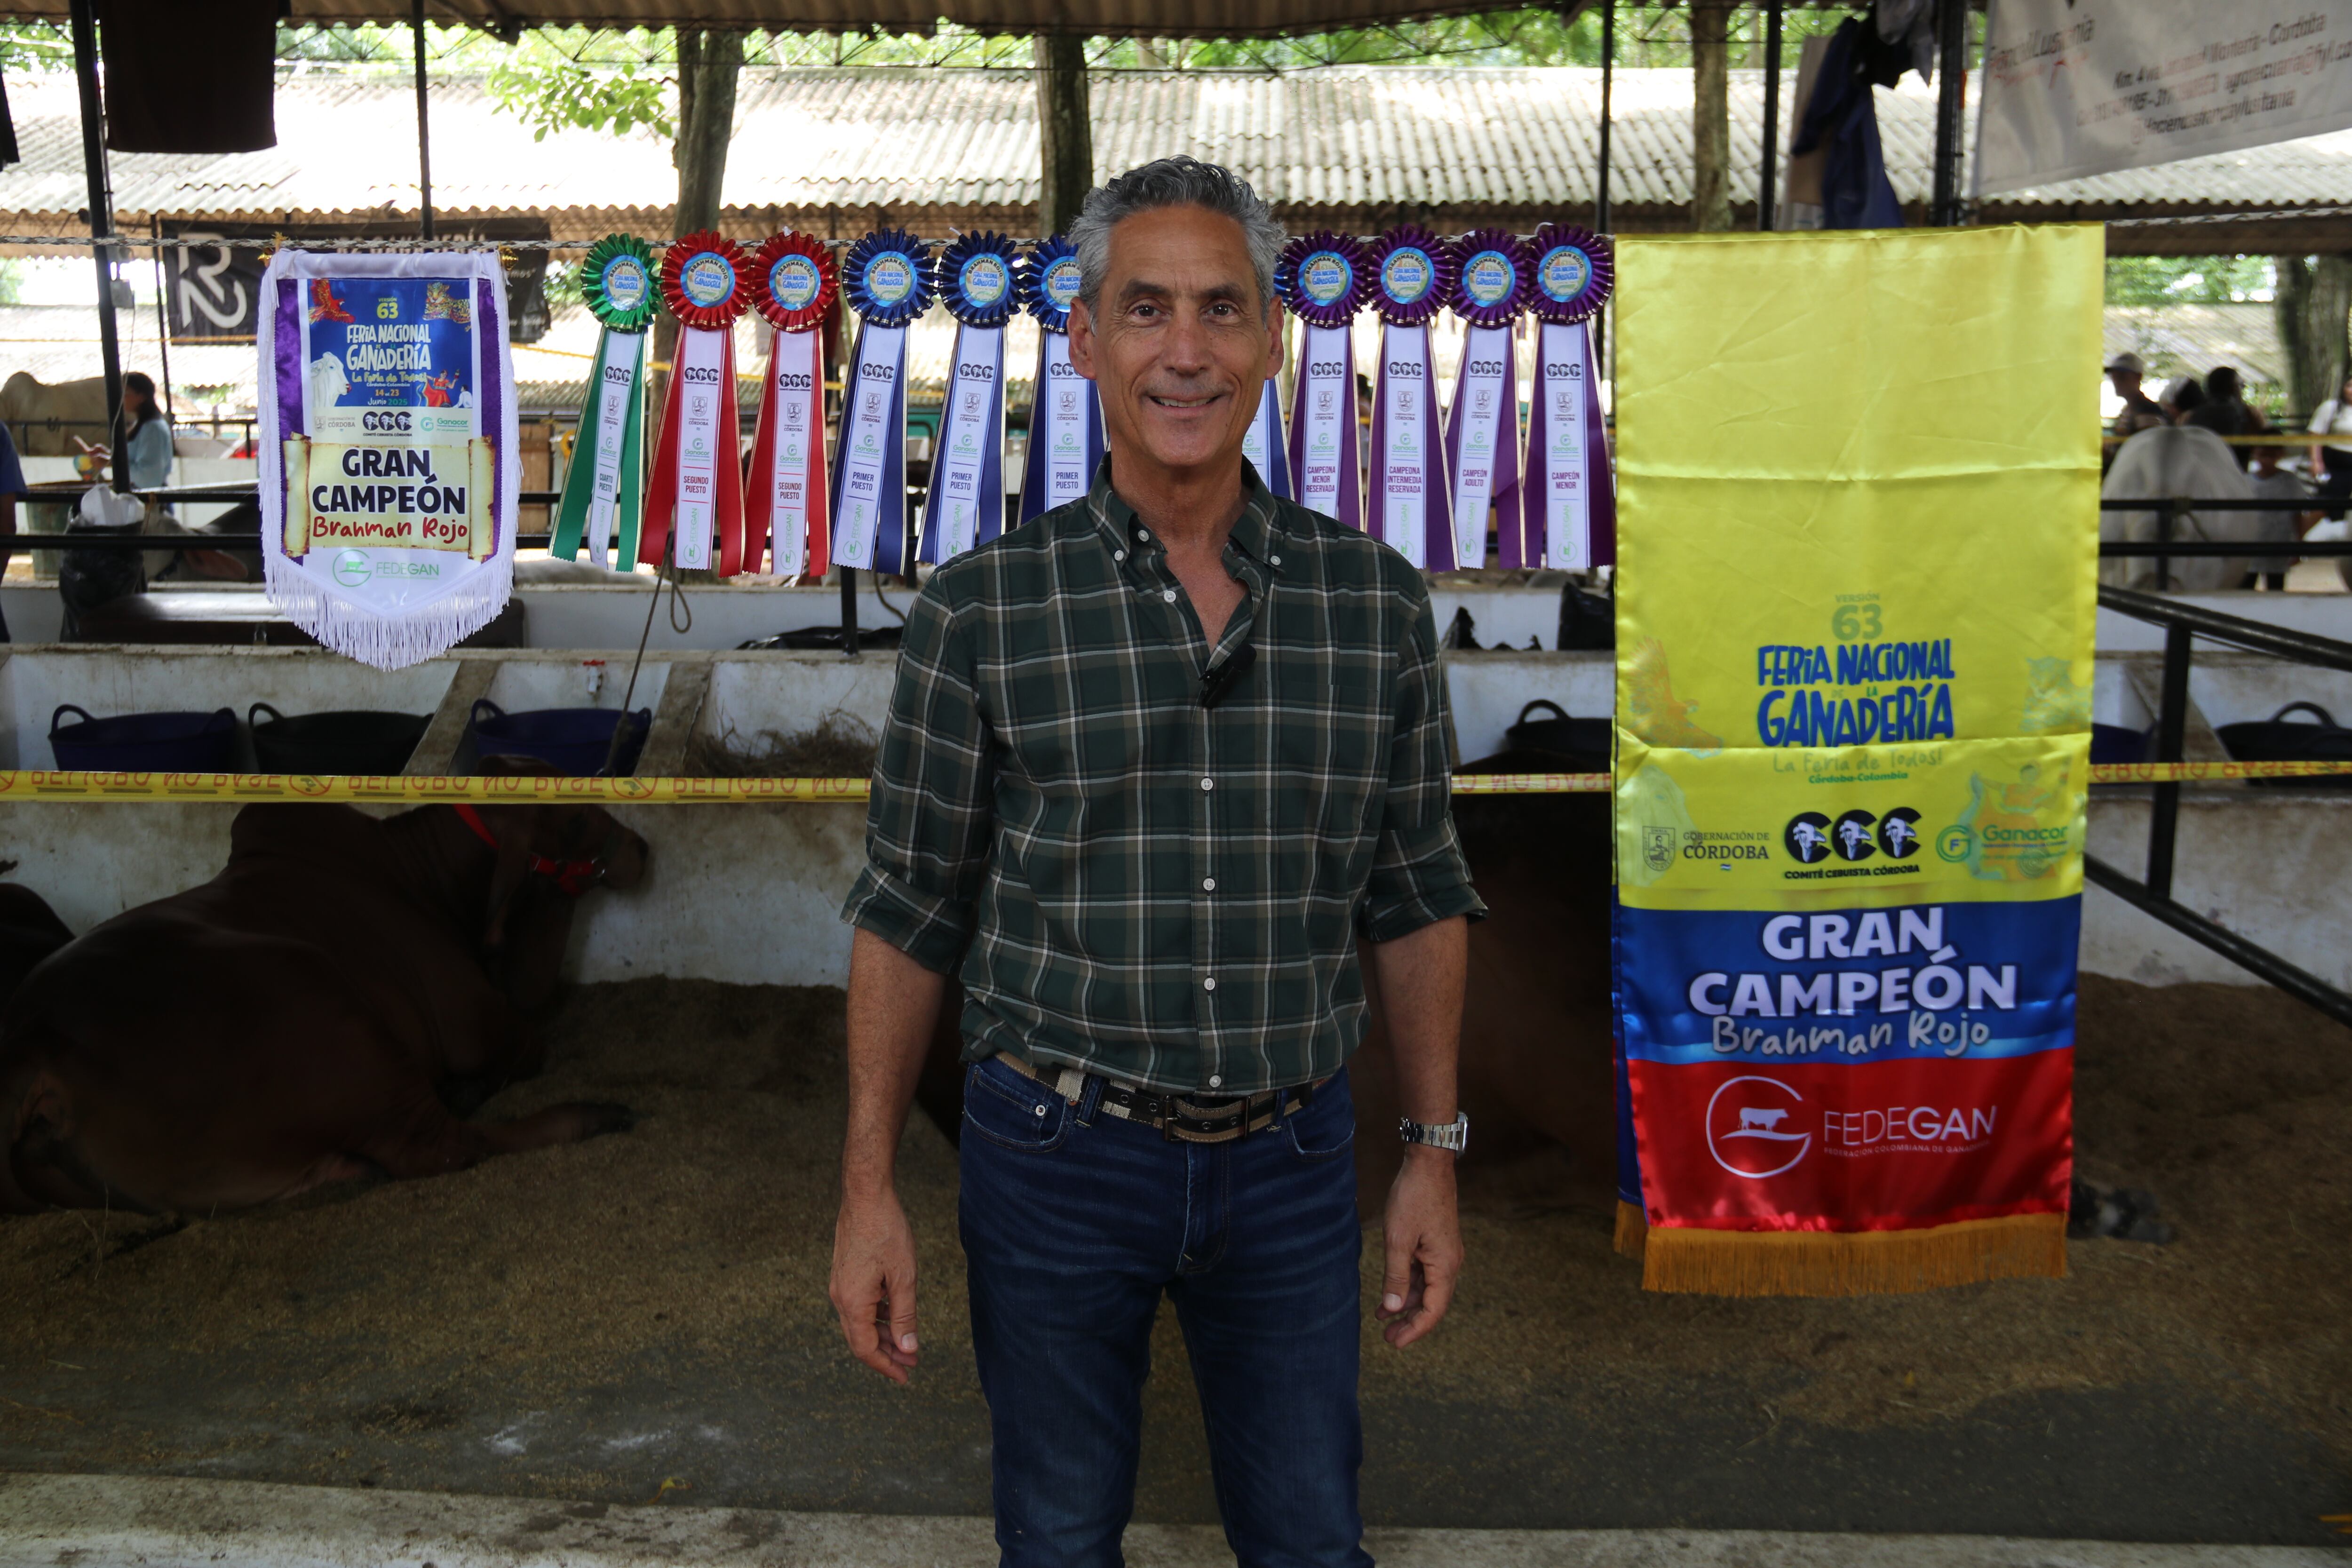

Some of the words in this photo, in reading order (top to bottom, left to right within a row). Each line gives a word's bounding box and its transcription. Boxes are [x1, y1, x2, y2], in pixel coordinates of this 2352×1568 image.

[690, 260, 718, 273] BRAHMAN
[718, 265, 728, 279] ROJO
[778, 261, 803, 276] BRAHMAN
[871, 258, 898, 274] BRAHMAN
[898, 262, 909, 275] ROJO
[968, 259, 993, 274] BRAHMAN
[993, 263, 1003, 277] ROJO
[1306, 257, 1331, 274] BRAHMAN
[1332, 259, 1343, 272] ROJO
[1388, 254, 1414, 271] BRAHMAN
[1414, 257, 1426, 271] ROJO
[1470, 258, 1496, 274] BRAHMAN
[1497, 262, 1507, 275] ROJO
[1545, 253, 1572, 270] BRAHMAN
[1572, 255, 1583, 268] ROJO
[610, 263, 633, 277] BRAHMAN
[633, 266, 643, 279] ROJO
[1049, 263, 1076, 279] BRAHMAN
[377, 302, 398, 319] 63
[352, 372, 362, 382] La
[364, 372, 384, 382] Feria
[386, 373, 397, 382] de
[600, 446, 617, 455] Ganacor
[342, 449, 430, 477] GRAN
[599, 473, 613, 483] CUARTO
[683, 476, 708, 485] SEGUNDO
[853, 471, 874, 482] PRIMER
[951, 472, 972, 481] PRIMER
[1462, 469, 1487, 478] CAMPEÓN
[1552, 471, 1580, 480] CAMPEÓN
[599, 482, 612, 493] PUESTO
[685, 485, 706, 493] PUESTO
[779, 482, 802, 491] SEGUNDO
[851, 481, 873, 491] PUESTO
[950, 481, 971, 490] PUESTO
[1464, 478, 1484, 487] ADULTO
[312, 473, 465, 514] CAMPEÓN
[851, 504, 862, 539] FEDEGAN
[952, 504, 961, 539] FEDEGAN
[313, 516, 411, 538] Brahman
[423, 517, 468, 544] Rojo
[376, 562, 439, 576] FEDEGAN
[1835, 591, 1880, 603] VERSIÓN
[1832, 603, 1883, 641] 63
[1832, 689, 1843, 698] DE
[1867, 686, 1877, 697] LA
[1757, 683, 1953, 747] GANADERÍA
[1773, 753, 1795, 772] La
[1804, 752, 1850, 772] Feria
[1856, 752, 1880, 770] de
[1890, 748, 1942, 769] Todos!
[1809, 771, 1908, 784] Córdoba-Colombia
[1683, 831, 1754, 840] GOBERNACIÓN
[1983, 824, 2068, 841] Ganacor
[1683, 841, 1769, 860] CÓRDOBA
[1785, 868, 1823, 879] COMITÉ
[1826, 868, 1870, 878] CEBUISTA
[1874, 865, 1920, 876] CÓRDOBA
[1763, 907, 1943, 961] GRAN
[1689, 944, 2017, 1017] CAMPEÓN
[1712, 1014, 1892, 1055] Brahman
[1908, 1011, 1990, 1057] Rojo
[1824, 1105, 1996, 1146] FEDEGAN
[1875, 1144, 1929, 1153] COLOMBIANA
